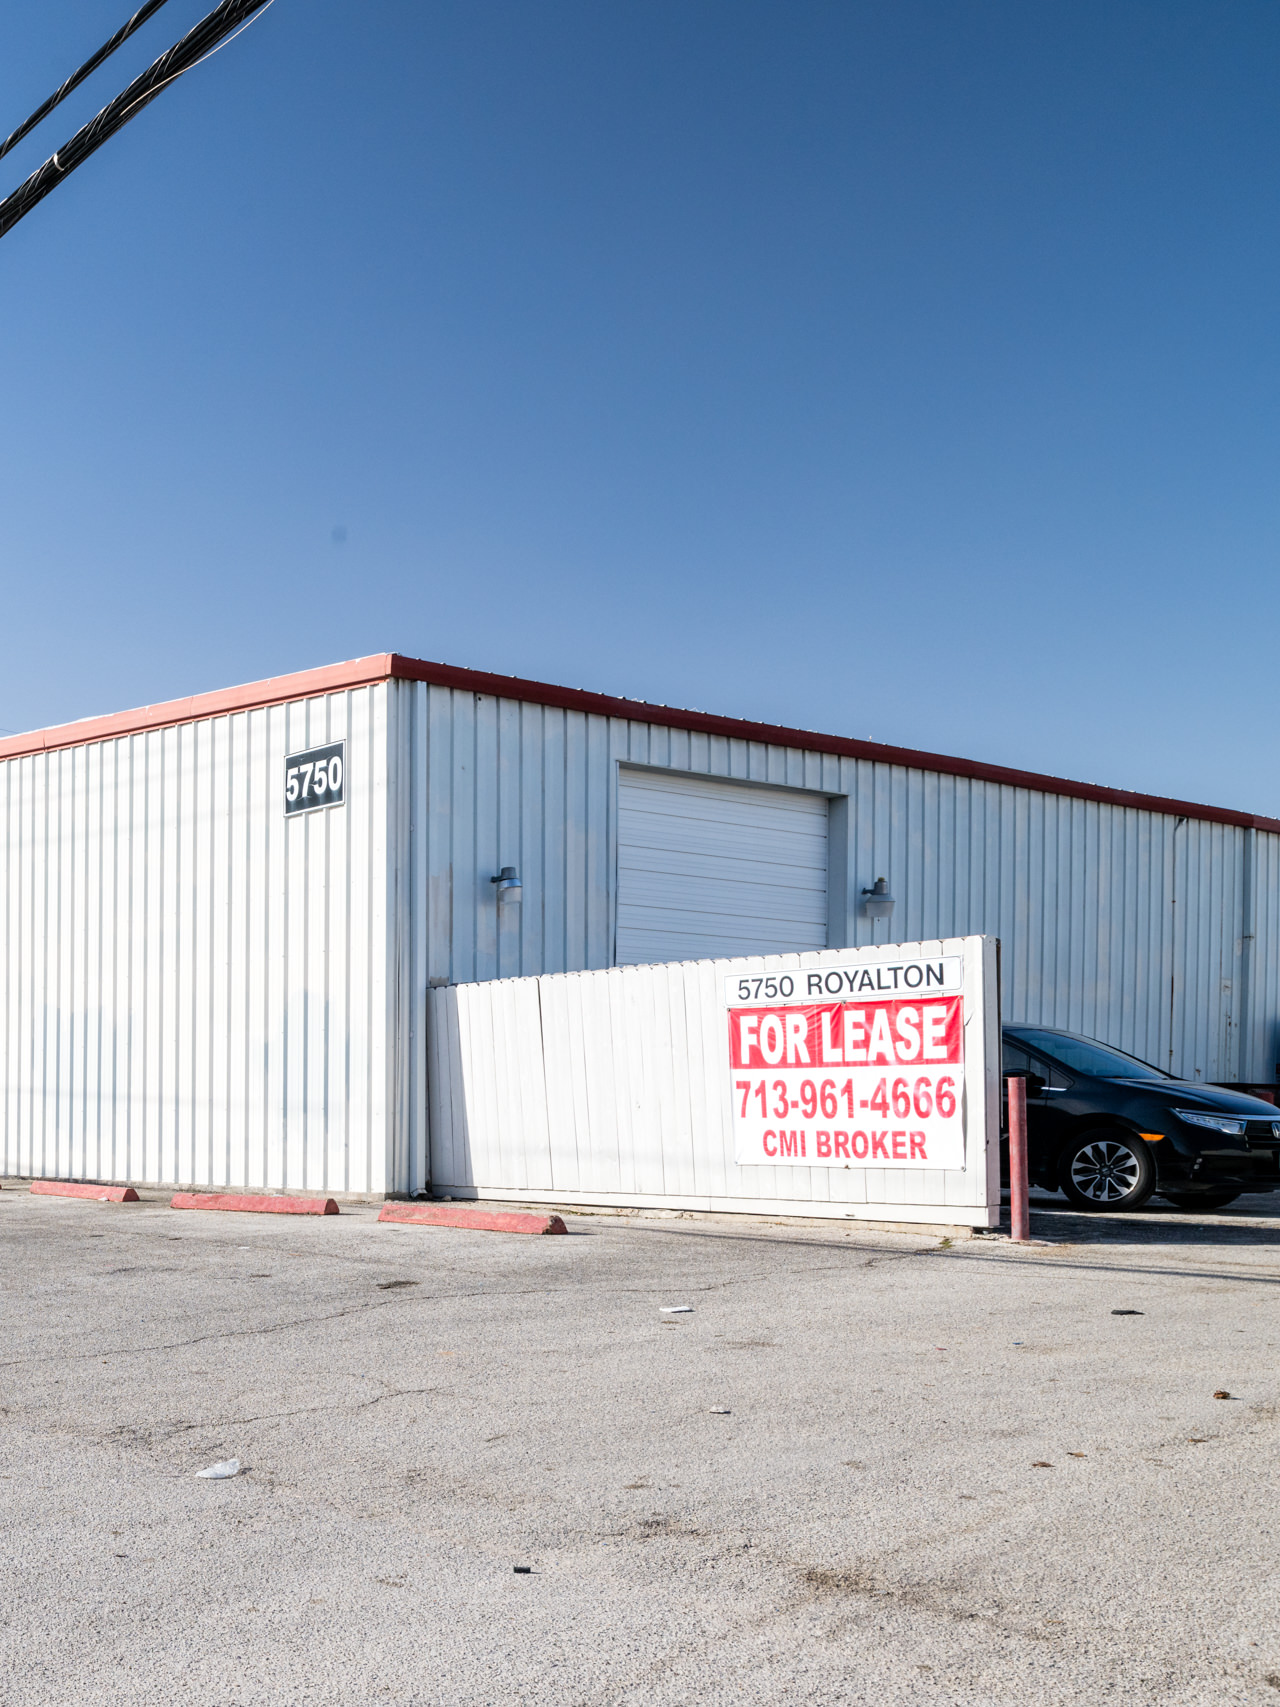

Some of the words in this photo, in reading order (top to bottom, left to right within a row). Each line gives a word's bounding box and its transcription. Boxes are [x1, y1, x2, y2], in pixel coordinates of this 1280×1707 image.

[286, 755, 343, 802] 5750
[737, 975, 795, 1000] 5750
[807, 962, 945, 996] ROYALTON
[739, 1013, 811, 1065] FOR
[821, 1005, 948, 1063] LEASE
[735, 1075, 957, 1119] 713-961-4666
[762, 1129, 807, 1158] CMI
[816, 1130, 929, 1160] BROKER
